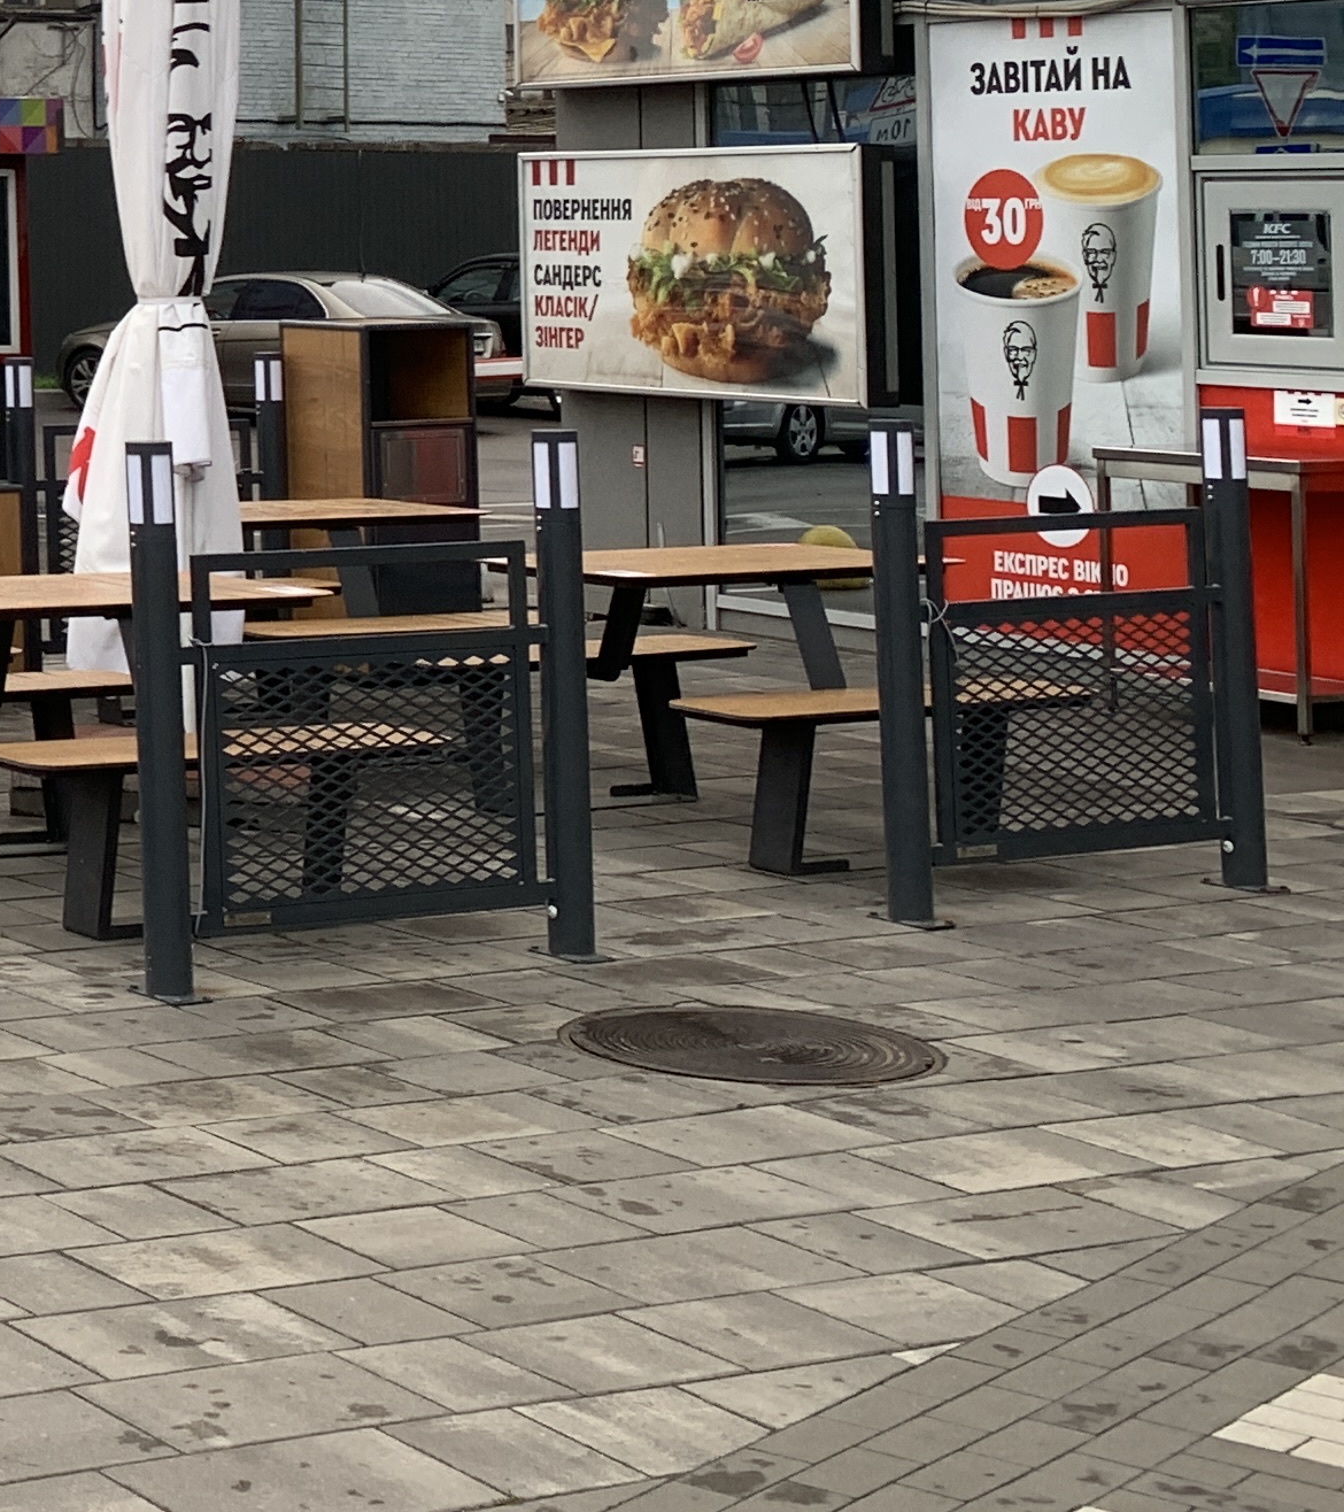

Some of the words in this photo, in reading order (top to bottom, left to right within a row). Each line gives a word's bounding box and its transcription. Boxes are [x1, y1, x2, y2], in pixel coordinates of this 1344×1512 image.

[970, 45, 1082, 95] ЗАВІТАЙ
[1091, 56, 1132, 91] НА
[1013, 107, 1086, 142] КАВУ
[533, 198, 632, 221] ПОВЕРНЕННЯ
[981, 197, 1027, 245] 30
[1263, 223, 1291, 234] KFC
[533, 229, 601, 256] ЛЕГЕНДИ
[534, 264, 602, 290] САНДЕРС
[534, 294, 599, 321] КЛАСІК/
[535, 325, 585, 349] ЗІНГЕР
[993, 550, 1070, 580] ЕКСПРЕС
